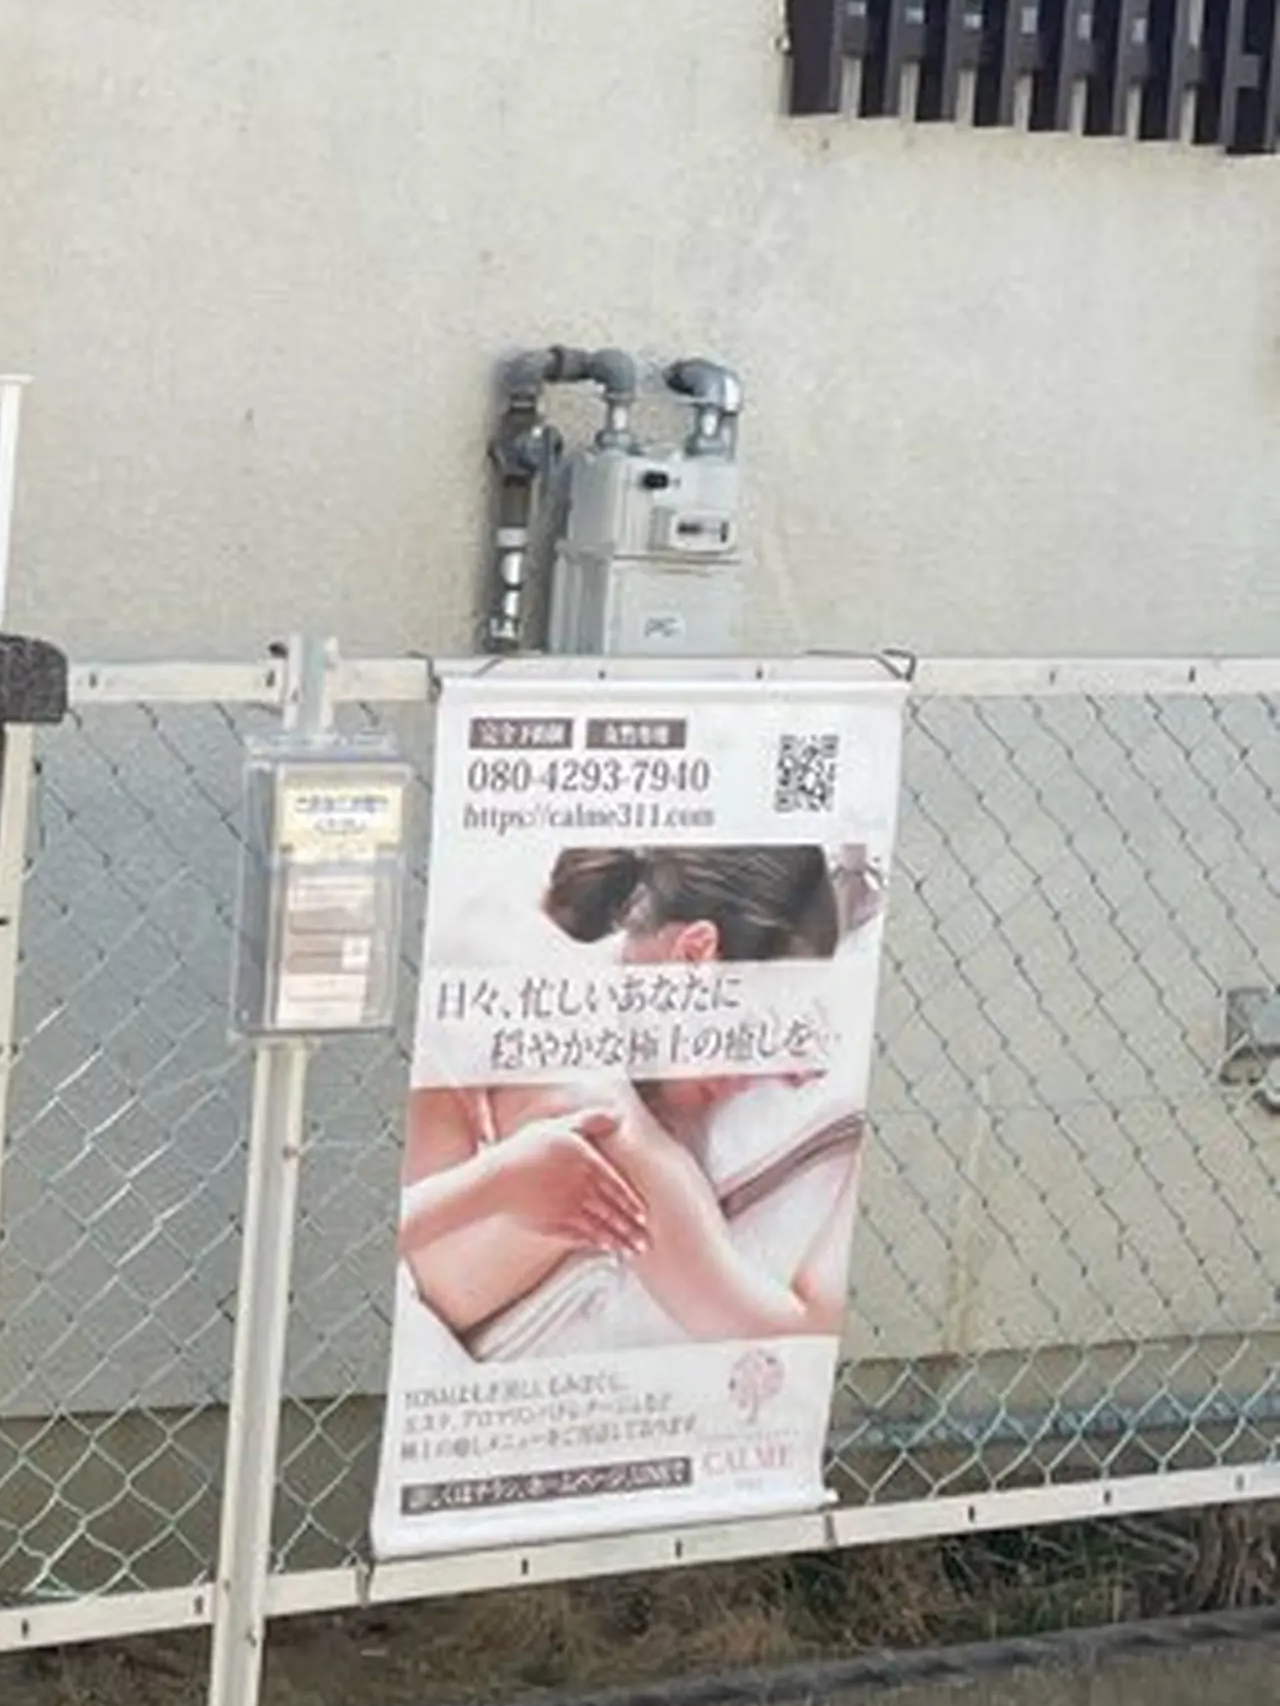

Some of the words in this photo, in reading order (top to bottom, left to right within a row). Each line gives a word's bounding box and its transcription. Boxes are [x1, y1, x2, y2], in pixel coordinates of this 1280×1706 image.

[467, 758, 711, 794] 080-4293-7940
[463, 801, 715, 835] https://calme311.com
[437, 975, 742, 1021] 日々、忙しいあなたに
